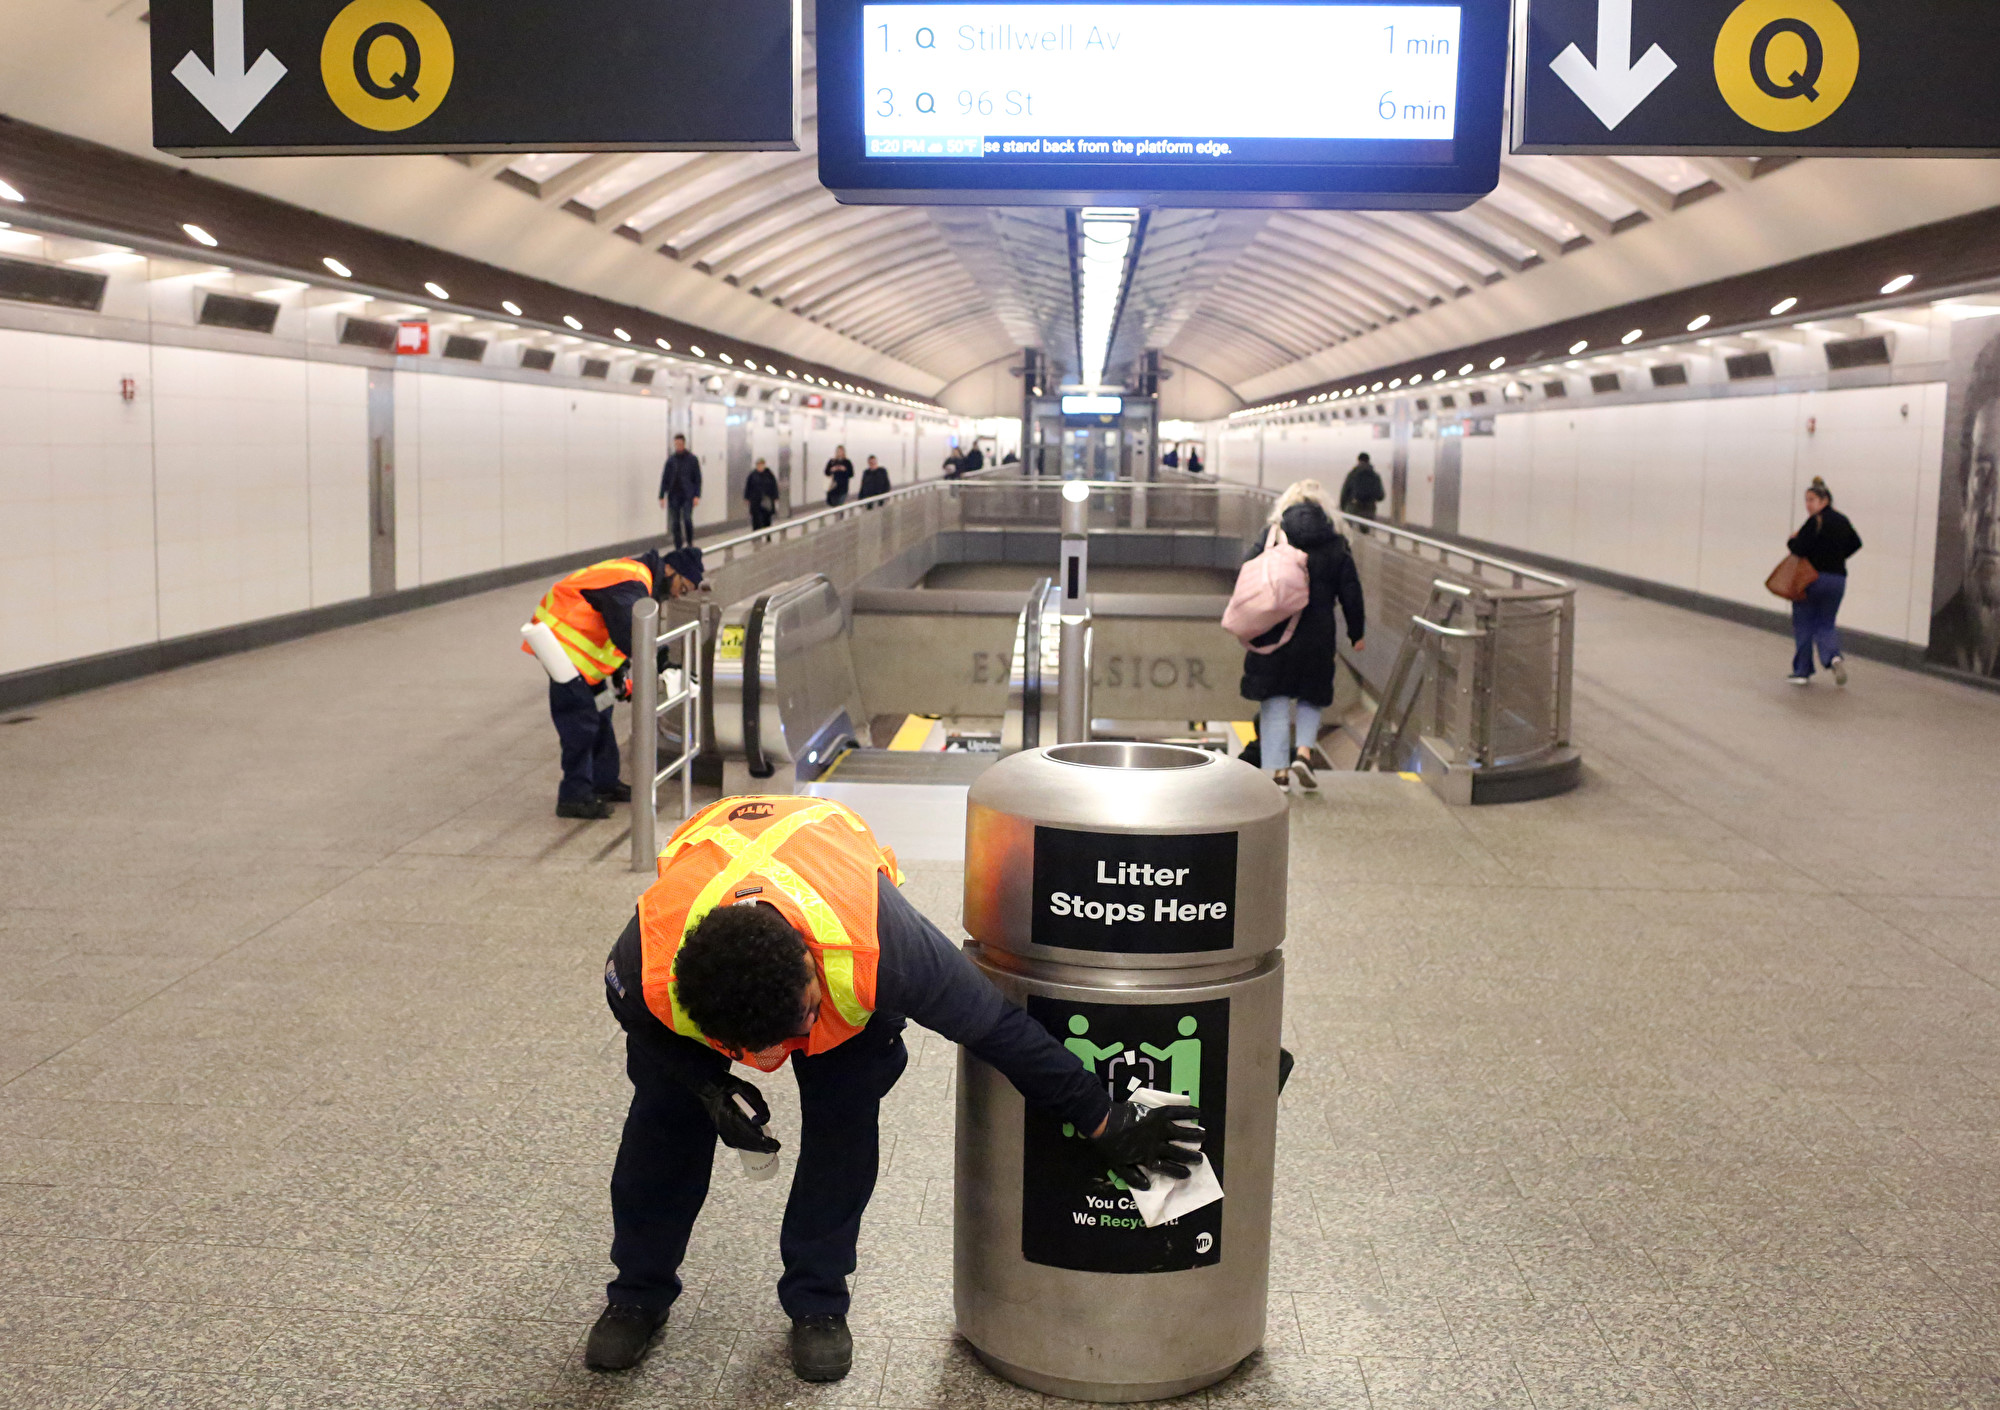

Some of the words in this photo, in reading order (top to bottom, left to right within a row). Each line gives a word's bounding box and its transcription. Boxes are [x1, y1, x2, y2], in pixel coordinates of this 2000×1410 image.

[876, 24, 902, 52] 1.
[915, 27, 936, 49] Q
[957, 24, 1073, 51] Stillwell
[1085, 25, 1121, 51] Av
[1383, 25, 1395, 54] 1
[1407, 34, 1449, 54] min
[353, 22, 421, 103] Q
[1749, 18, 1823, 103] Q
[876, 87, 902, 117] 3.
[915, 92, 936, 114] Q
[957, 90, 993, 116] 96
[1005, 90, 1033, 116] St
[1378, 91, 1396, 120] 6
[1403, 100, 1445, 120] min
[903, 139, 925, 153] PM
[1003, 139, 1040, 153] stand
[1043, 139, 1075, 153] back
[1077, 139, 1110, 153] from
[1112, 139, 1134, 154] the
[1136, 139, 1193, 156] platform
[1196, 140, 1232, 157] edge.
[736, 804, 774, 817] MTA
[1097, 860, 1190, 886] Litter
[1050, 891, 1146, 926] Stops
[1154, 898, 1227, 922] Here
[1085, 1195, 1114, 1210] You
[1117, 1197, 1138, 1211] Ca
[1072, 1212, 1096, 1226] We
[1100, 1214, 1145, 1230] Recyc
